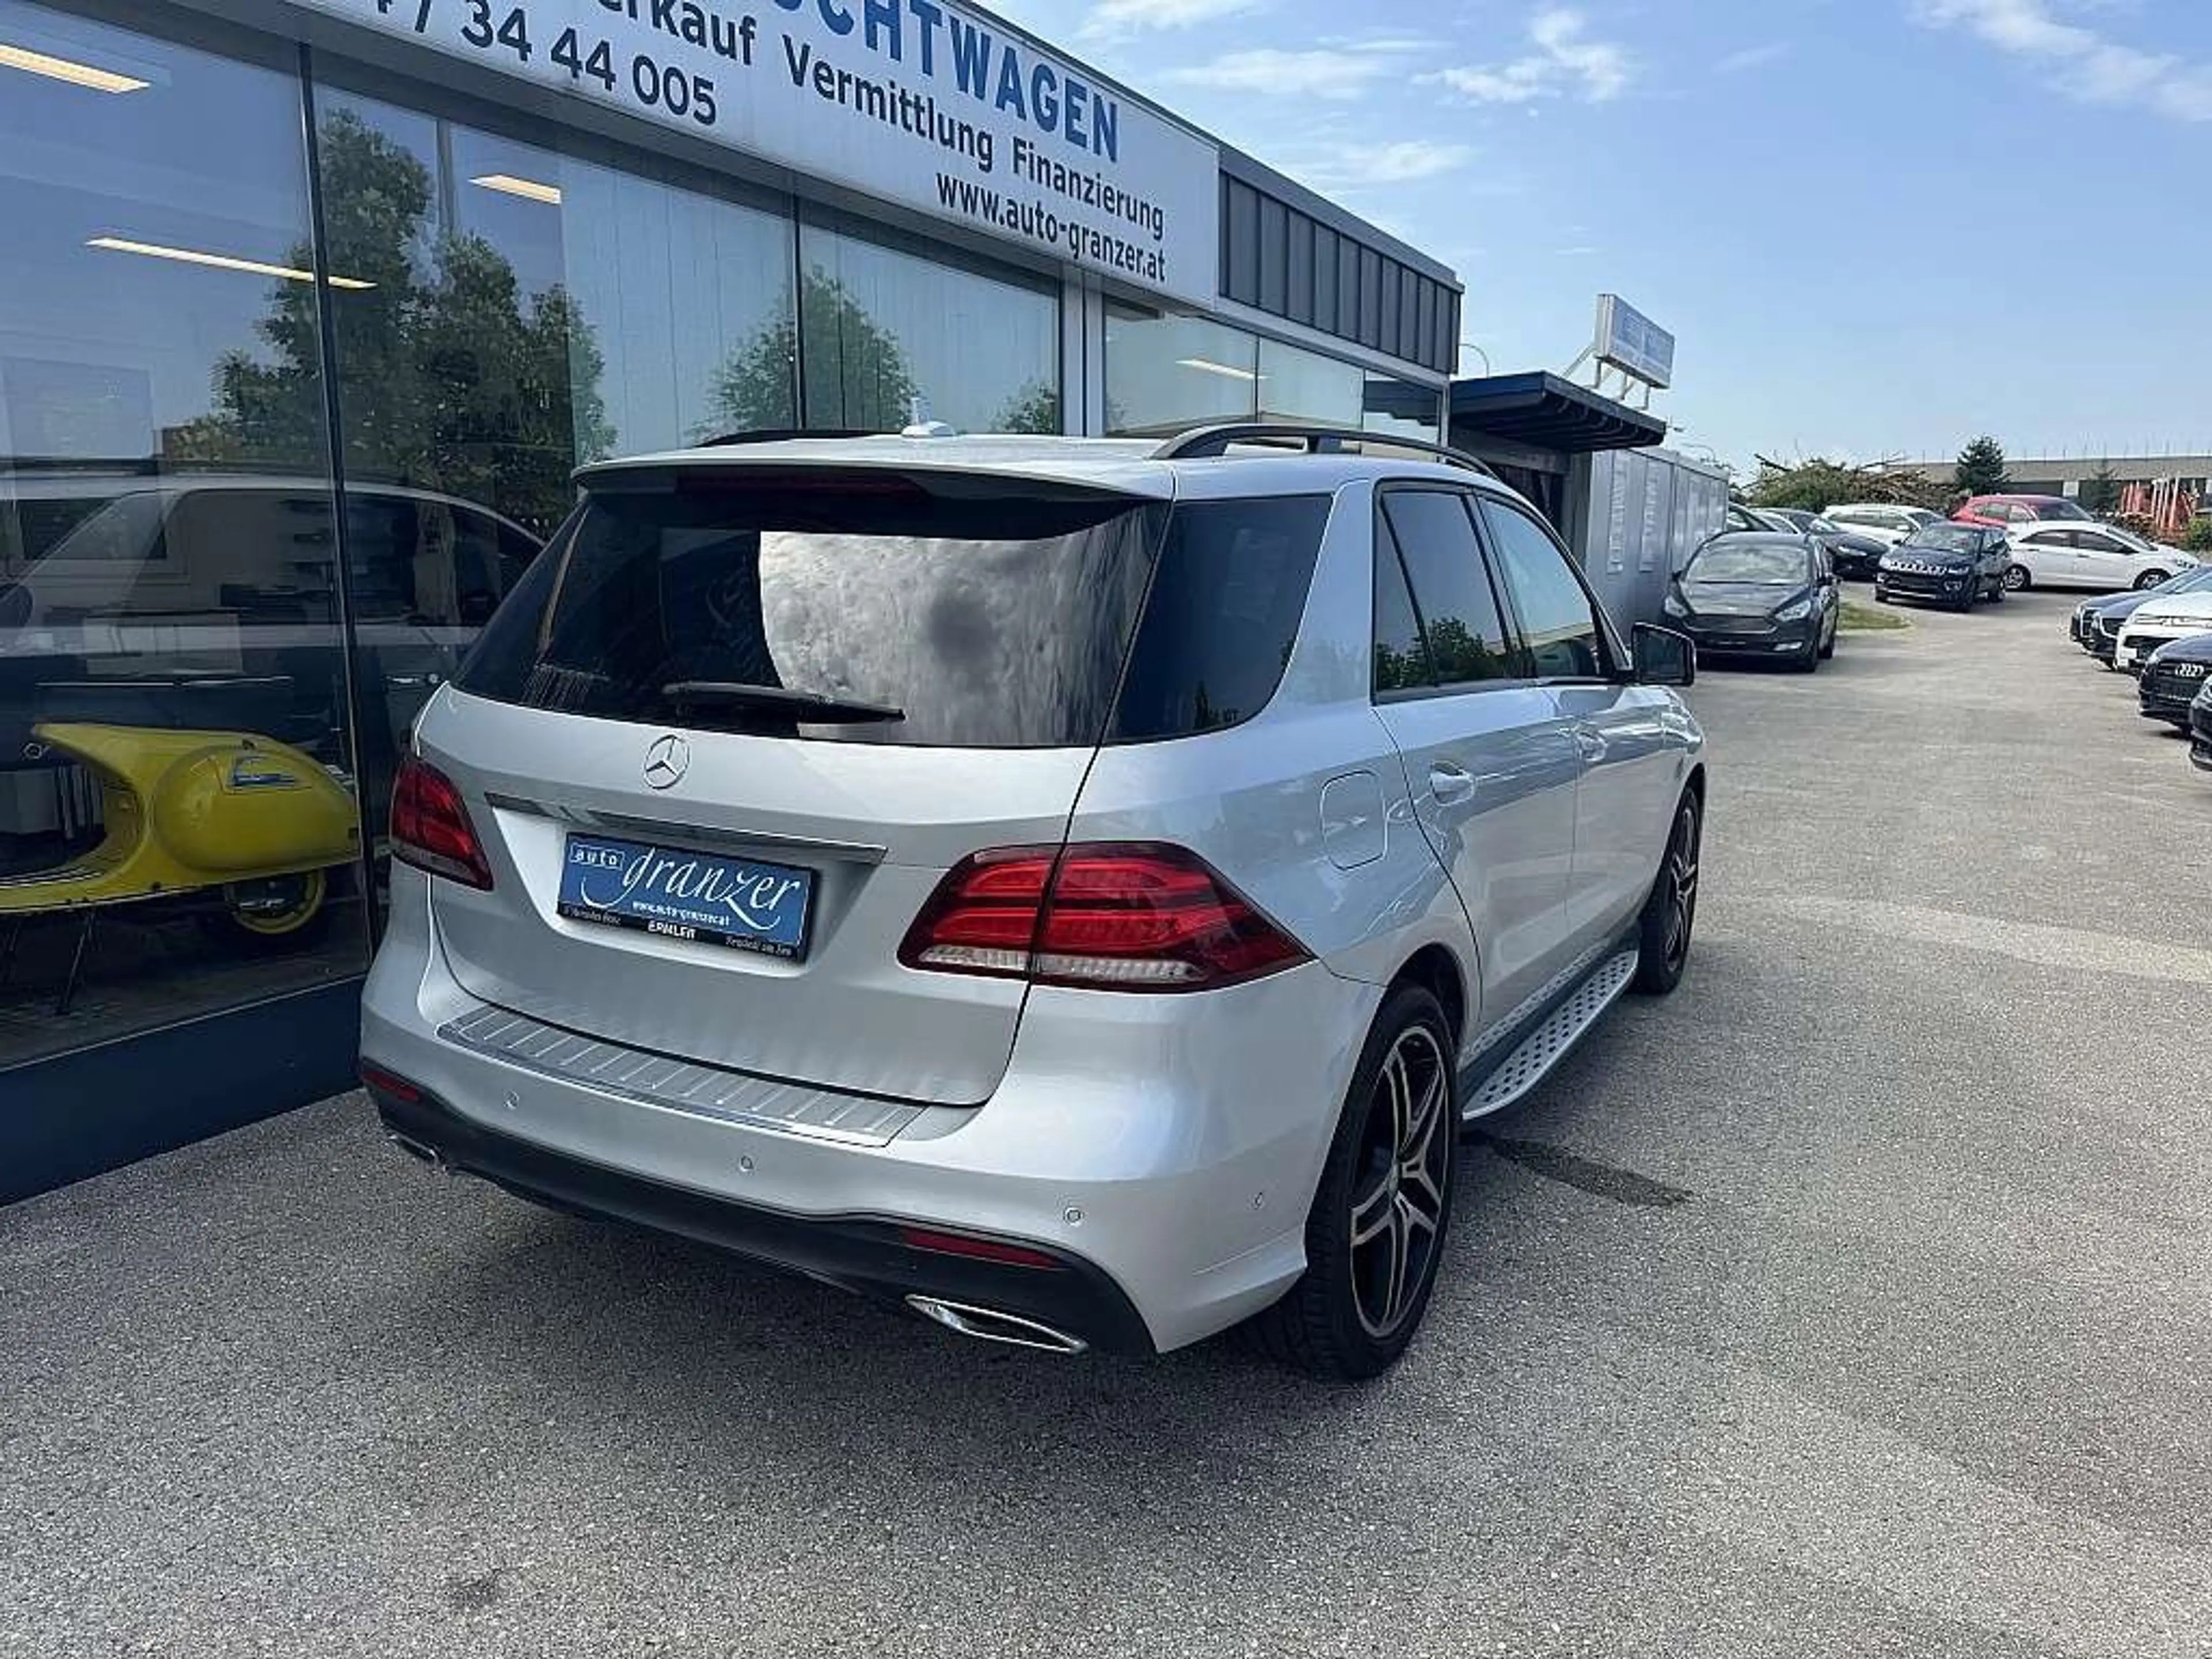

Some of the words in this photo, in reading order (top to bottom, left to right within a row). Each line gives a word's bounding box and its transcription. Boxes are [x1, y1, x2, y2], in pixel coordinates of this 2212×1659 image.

[461, 0, 532, 62] 34
[550, 26, 616, 91] 44
[632, 55, 716, 126] 005
[782, 34, 993, 173] Vermittlung
[1012, 136, 1165, 243] Finanzierung
[937, 172, 1166, 283] www.auto-granzer.at
[575, 850, 618, 866] auto
[581, 846, 800, 930] granzer
